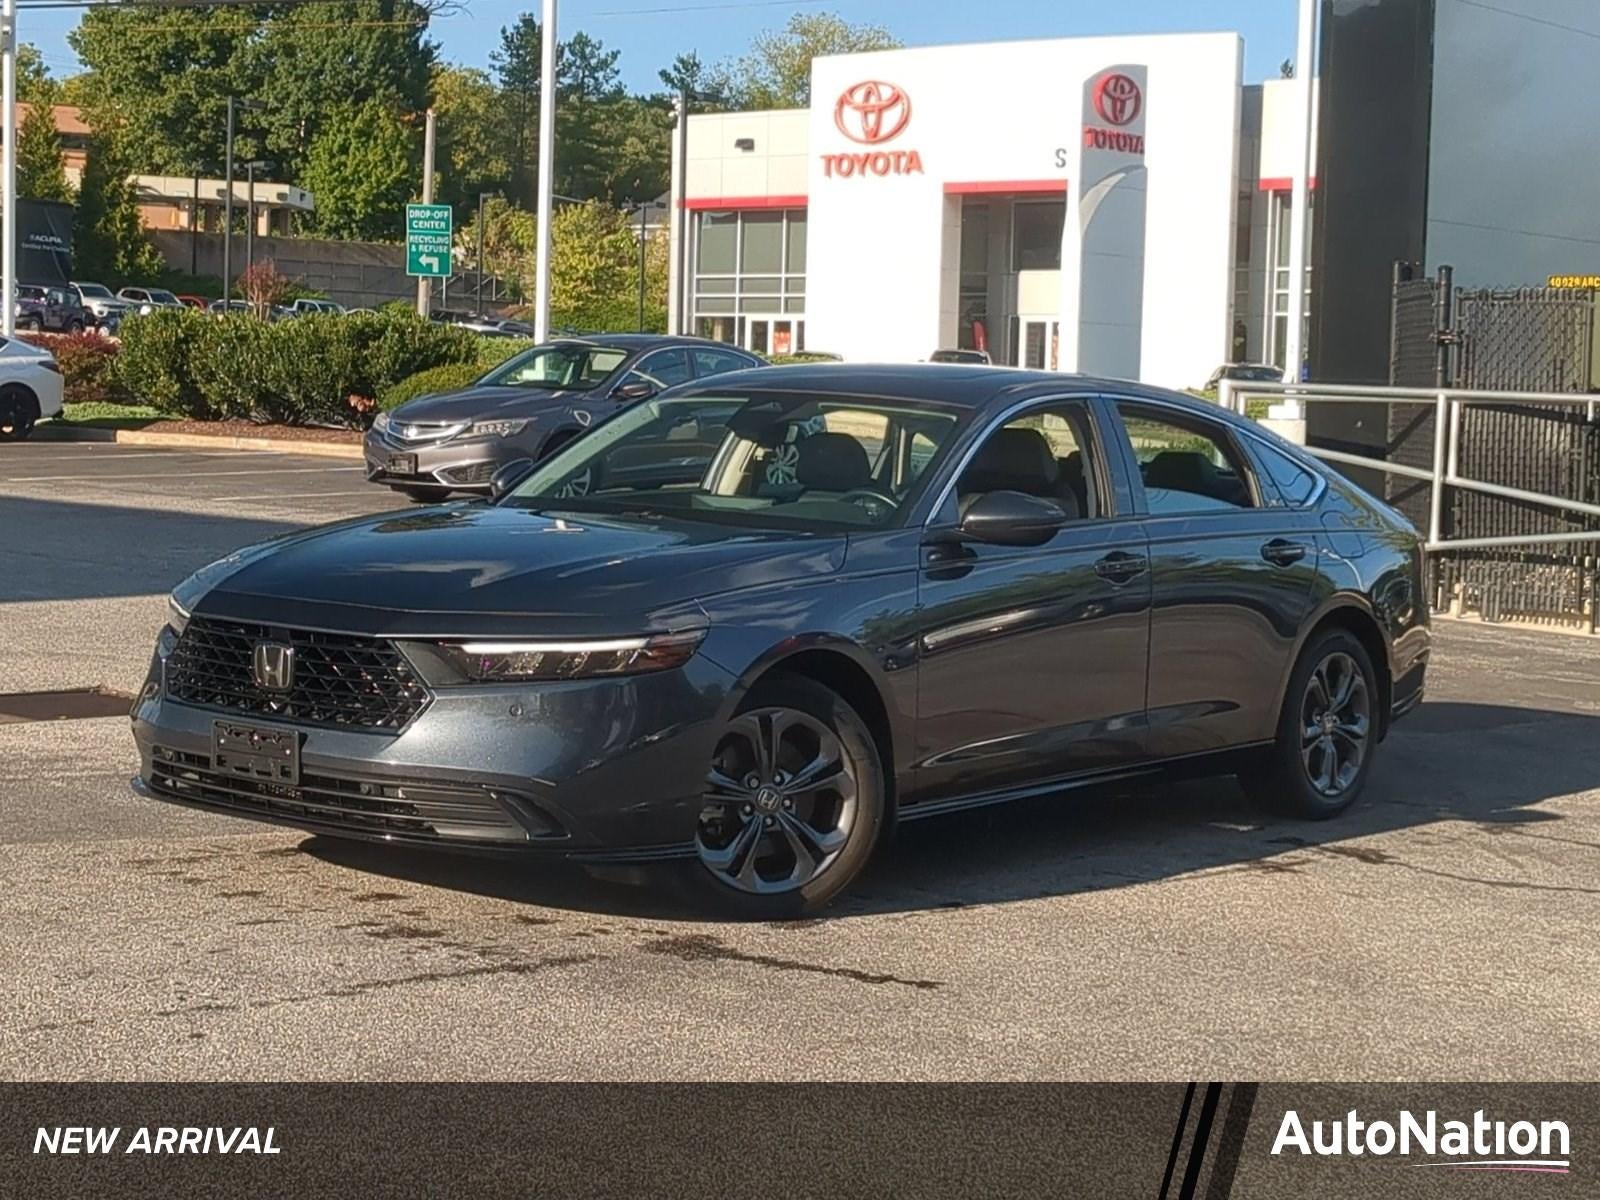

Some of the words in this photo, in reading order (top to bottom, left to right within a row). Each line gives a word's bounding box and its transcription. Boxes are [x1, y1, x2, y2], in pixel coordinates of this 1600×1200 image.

[820, 150, 925, 178] TOYOTA
[409, 210, 449, 219] DROP-OFF
[412, 219, 446, 229] CENTER
[409, 234, 449, 244] RECYCLING
[419, 244, 448, 253] REFUSE
